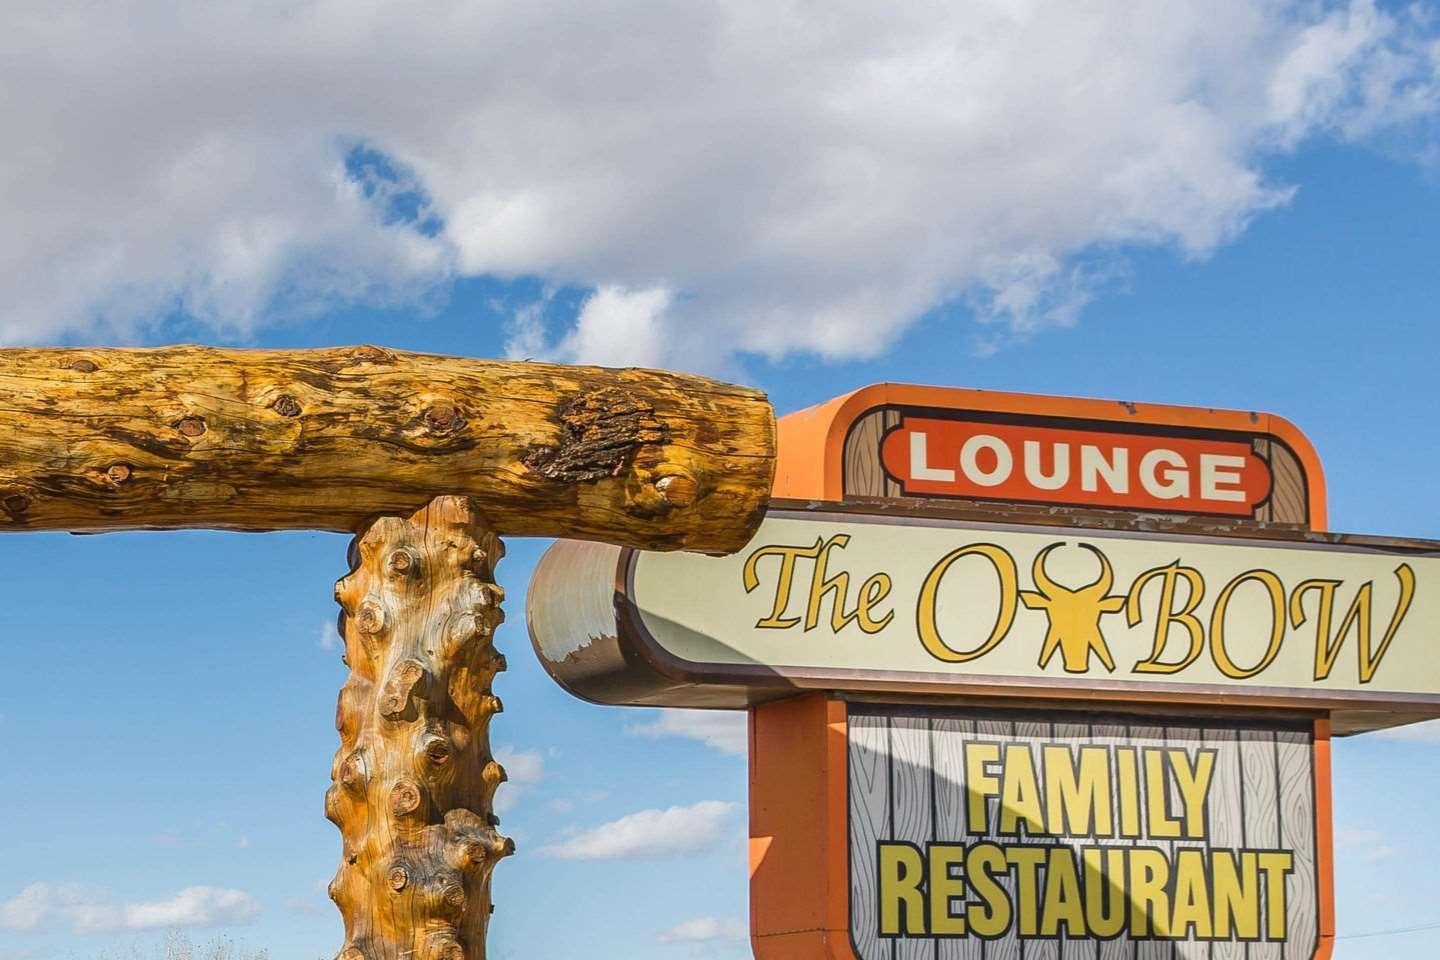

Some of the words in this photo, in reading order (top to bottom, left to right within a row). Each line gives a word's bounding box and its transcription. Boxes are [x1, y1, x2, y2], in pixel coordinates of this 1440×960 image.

[909, 431, 1247, 503] LOUNGE
[743, 533, 895, 634] The
[963, 740, 1219, 840] FAMILY
[876, 840, 1295, 943] RESTAURANT
